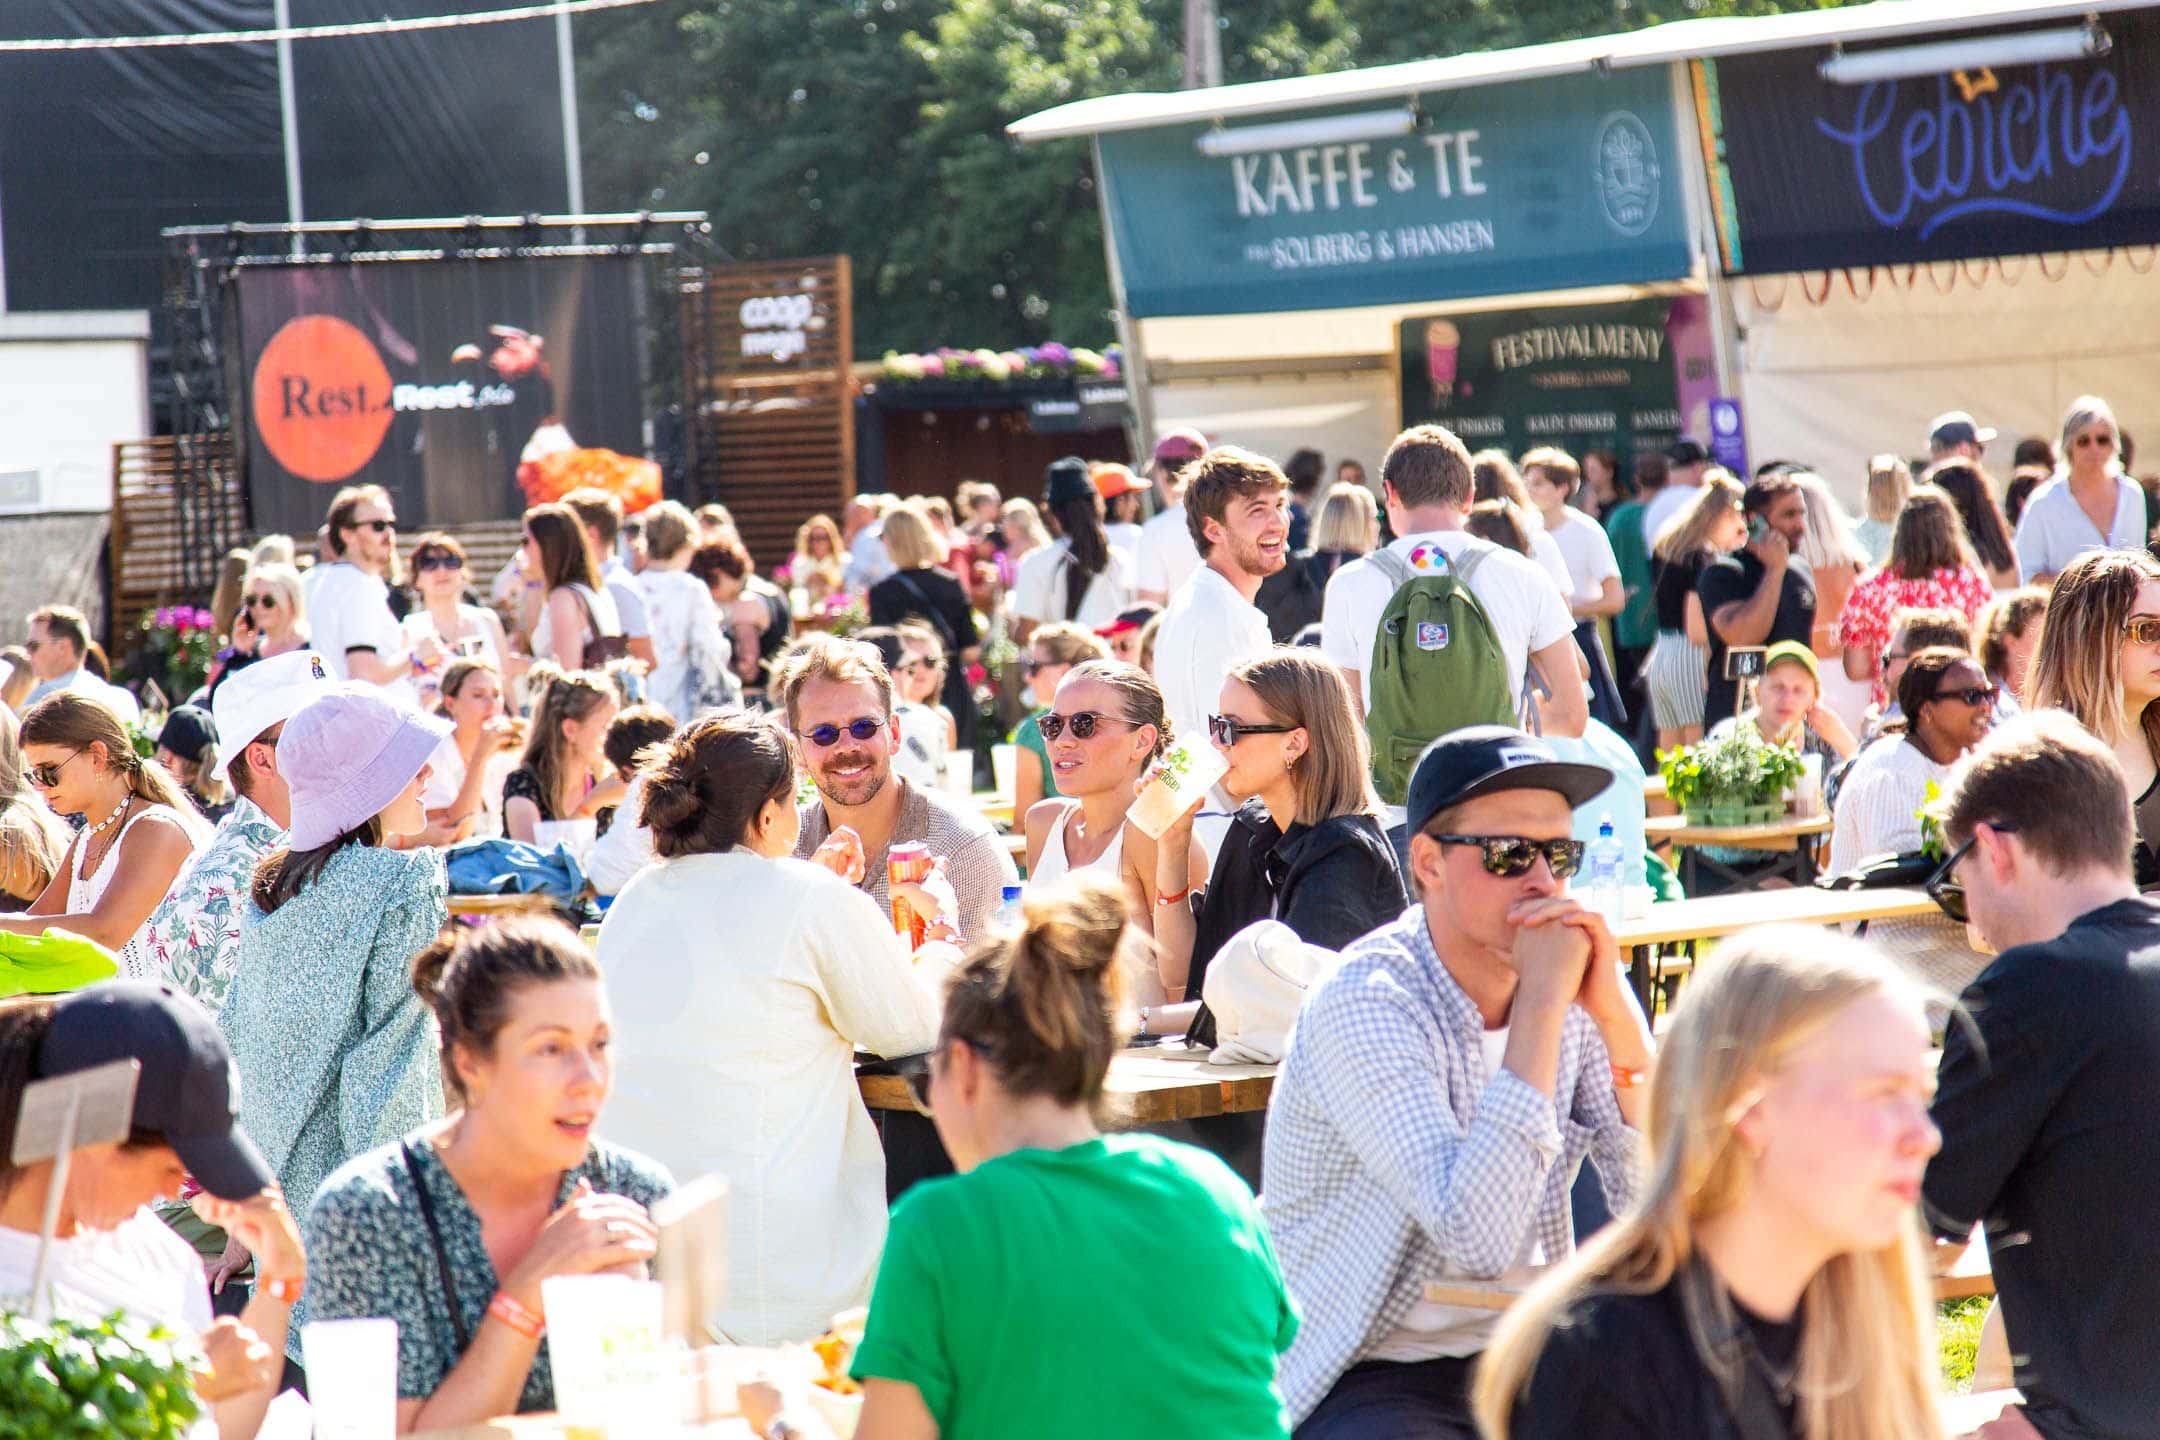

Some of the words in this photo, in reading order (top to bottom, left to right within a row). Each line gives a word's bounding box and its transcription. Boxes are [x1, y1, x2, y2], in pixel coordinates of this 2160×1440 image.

[1231, 142, 1378, 217] KAFFE
[1387, 148, 1415, 193] &
[1424, 129, 1487, 199] TE
[1270, 230, 1373, 270] SOLBERG
[1375, 229, 1396, 262] &
[1397, 216, 1495, 258] HANSEN
[1492, 325, 1664, 370] FESTIVALMENY
